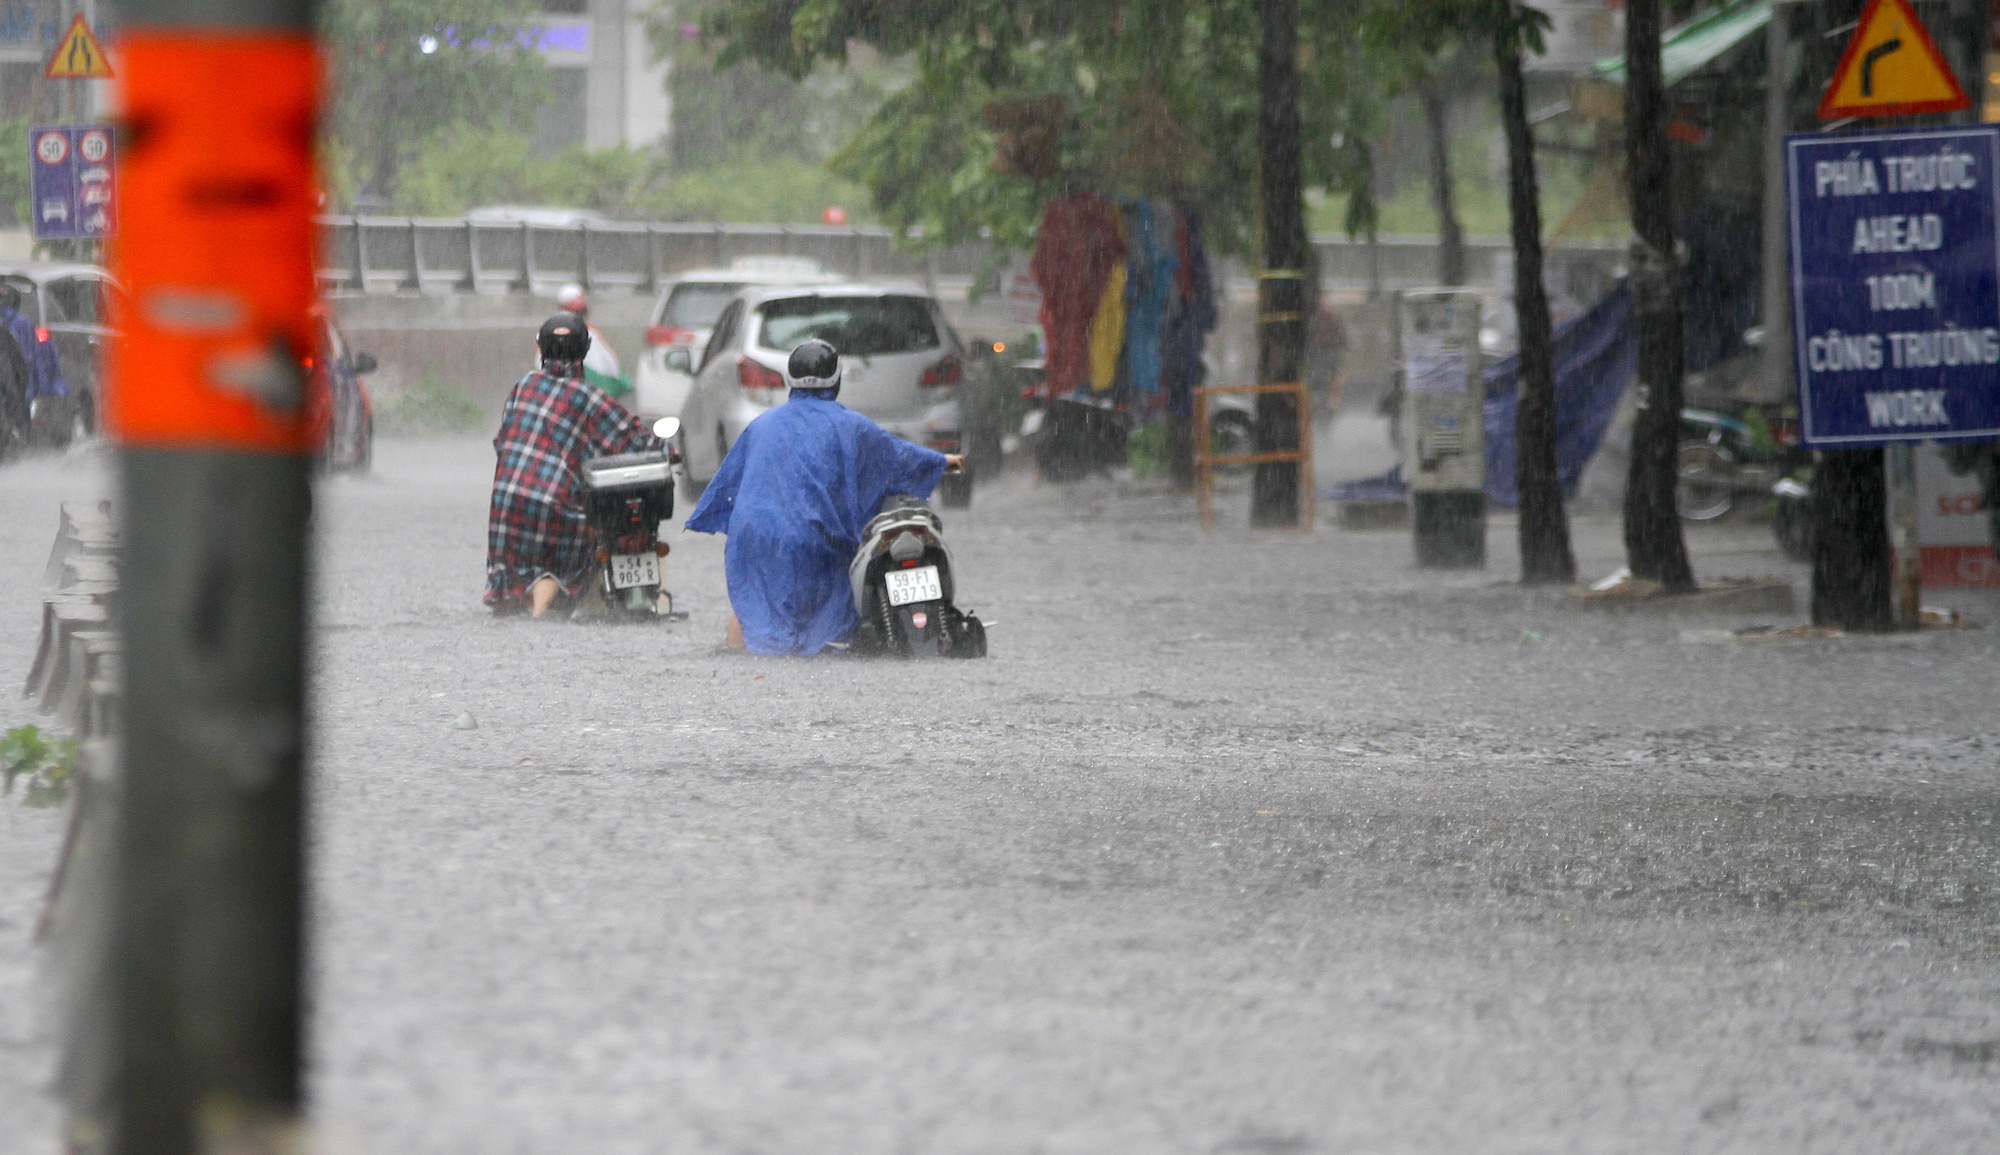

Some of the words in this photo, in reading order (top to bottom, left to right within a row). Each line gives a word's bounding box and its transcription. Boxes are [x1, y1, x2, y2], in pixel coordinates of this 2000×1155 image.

[43, 140, 60, 157] 50
[88, 139, 103, 158] 50
[1815, 150, 1881, 198] PHÍA
[1853, 213, 1944, 254] AHEAD
[1865, 271, 1936, 313] 100M
[1809, 328, 1884, 373] CÔNG
[1865, 389, 1951, 428] WORK
[626, 556, 641, 570] 54
